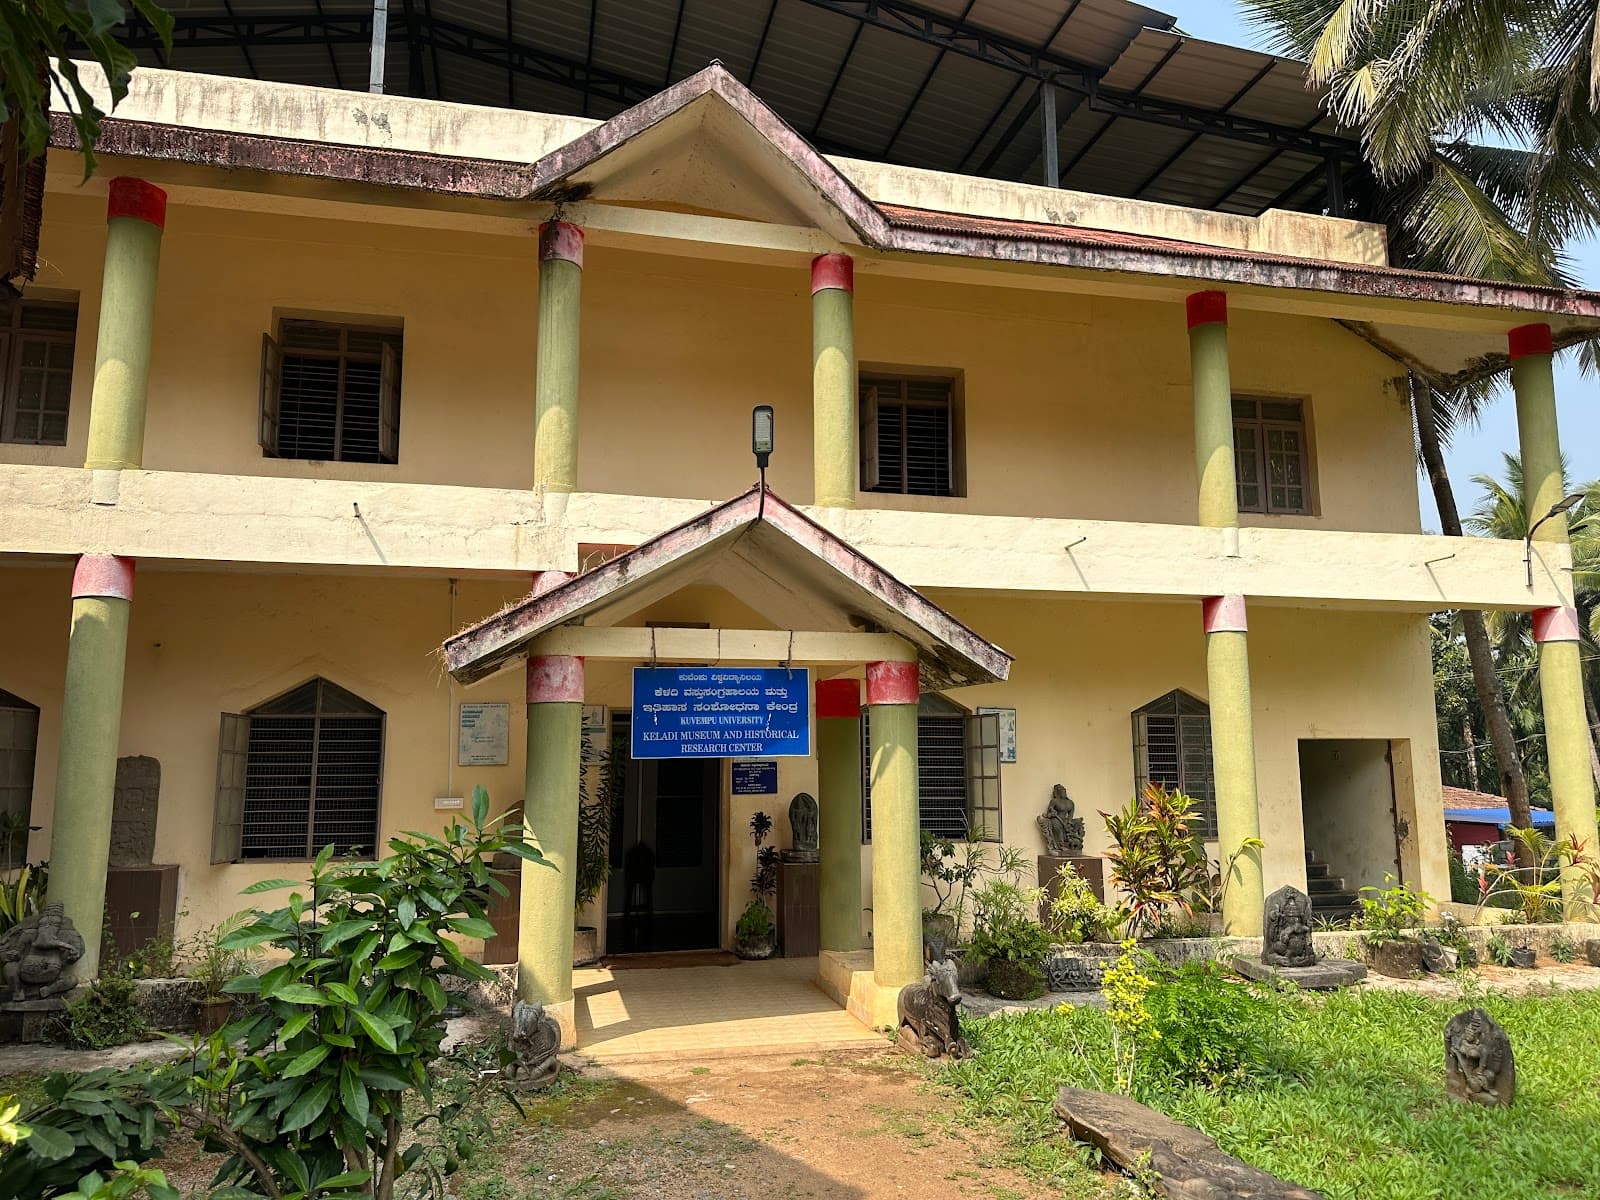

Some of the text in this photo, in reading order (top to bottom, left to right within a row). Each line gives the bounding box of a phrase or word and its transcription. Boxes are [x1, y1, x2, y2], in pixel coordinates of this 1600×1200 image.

[654, 687, 788, 699] ಕೆಳದಿ ವಸ್ತುಸಂಗ್ರಹಾಲಯ ಮತ್ತು
[643, 701, 798, 714] ಇತಿಹಾಸ ಸಂಶೋಧನಾ ಕೇಂದ್ರ
[680, 715, 764, 726] KUVEMPU UNIVERSITY
[642, 730, 799, 741] KELADI MUSEUM AND HISTORICAL
[681, 742, 763, 753] RESEARCH CENTER
